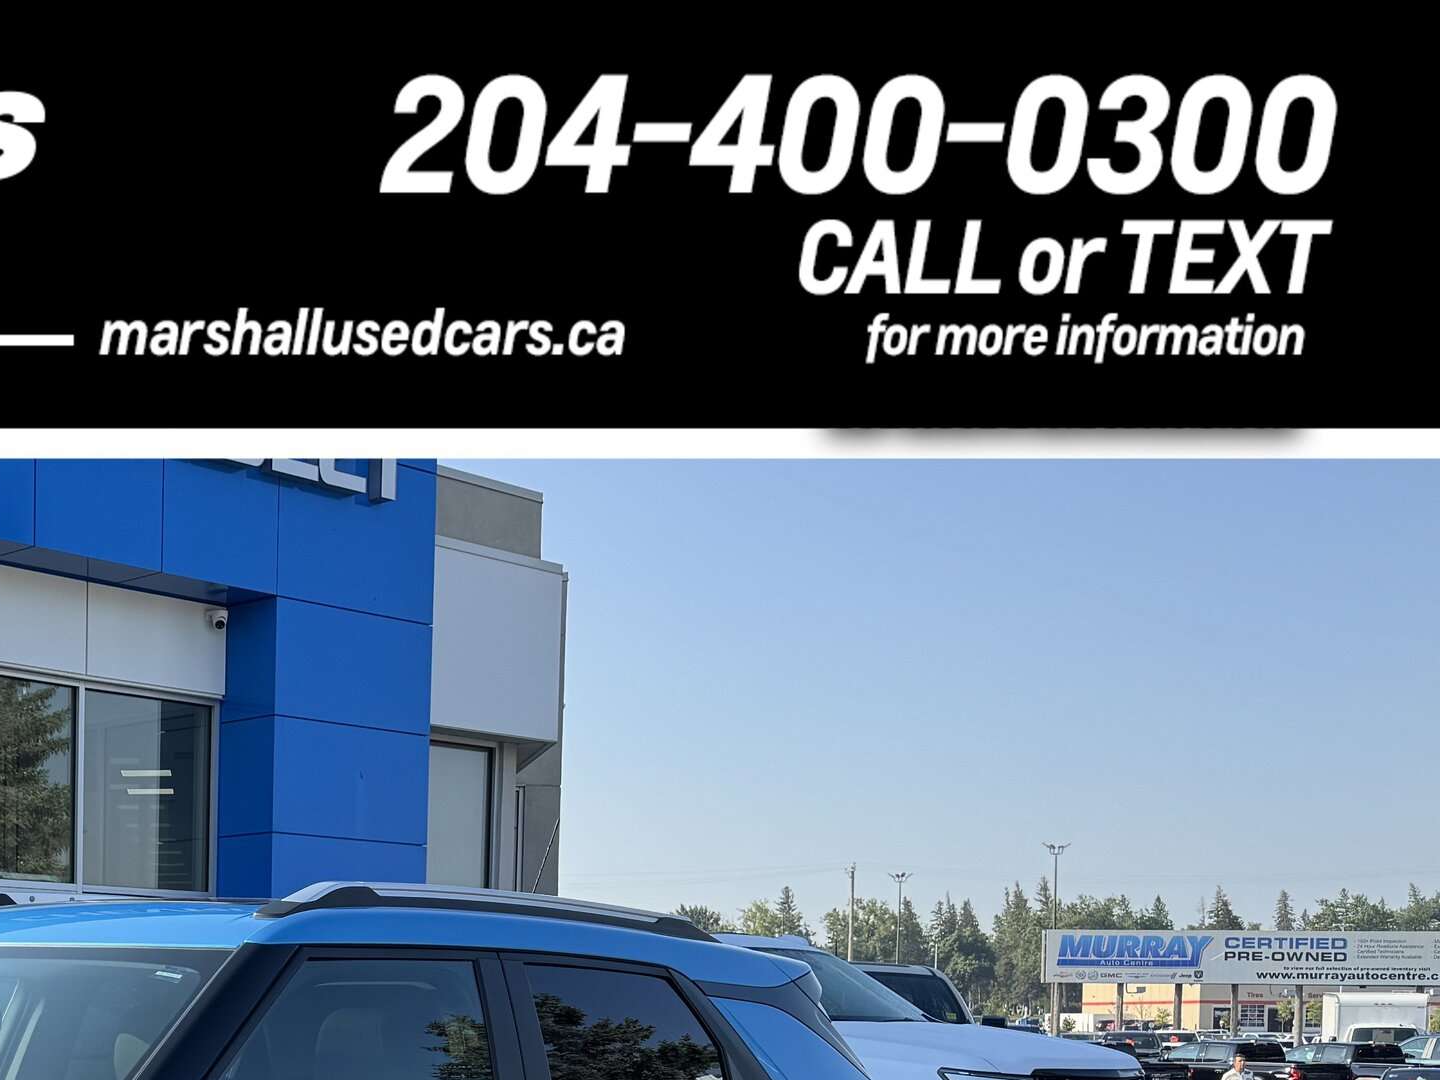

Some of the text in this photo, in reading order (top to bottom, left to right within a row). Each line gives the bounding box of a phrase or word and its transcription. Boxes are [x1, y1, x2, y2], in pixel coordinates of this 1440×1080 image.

[1057, 934, 1215, 964] MURRAY
[1224, 936, 1348, 950] CERTIFIED
[1224, 951, 1348, 962] PRE-OWNED
